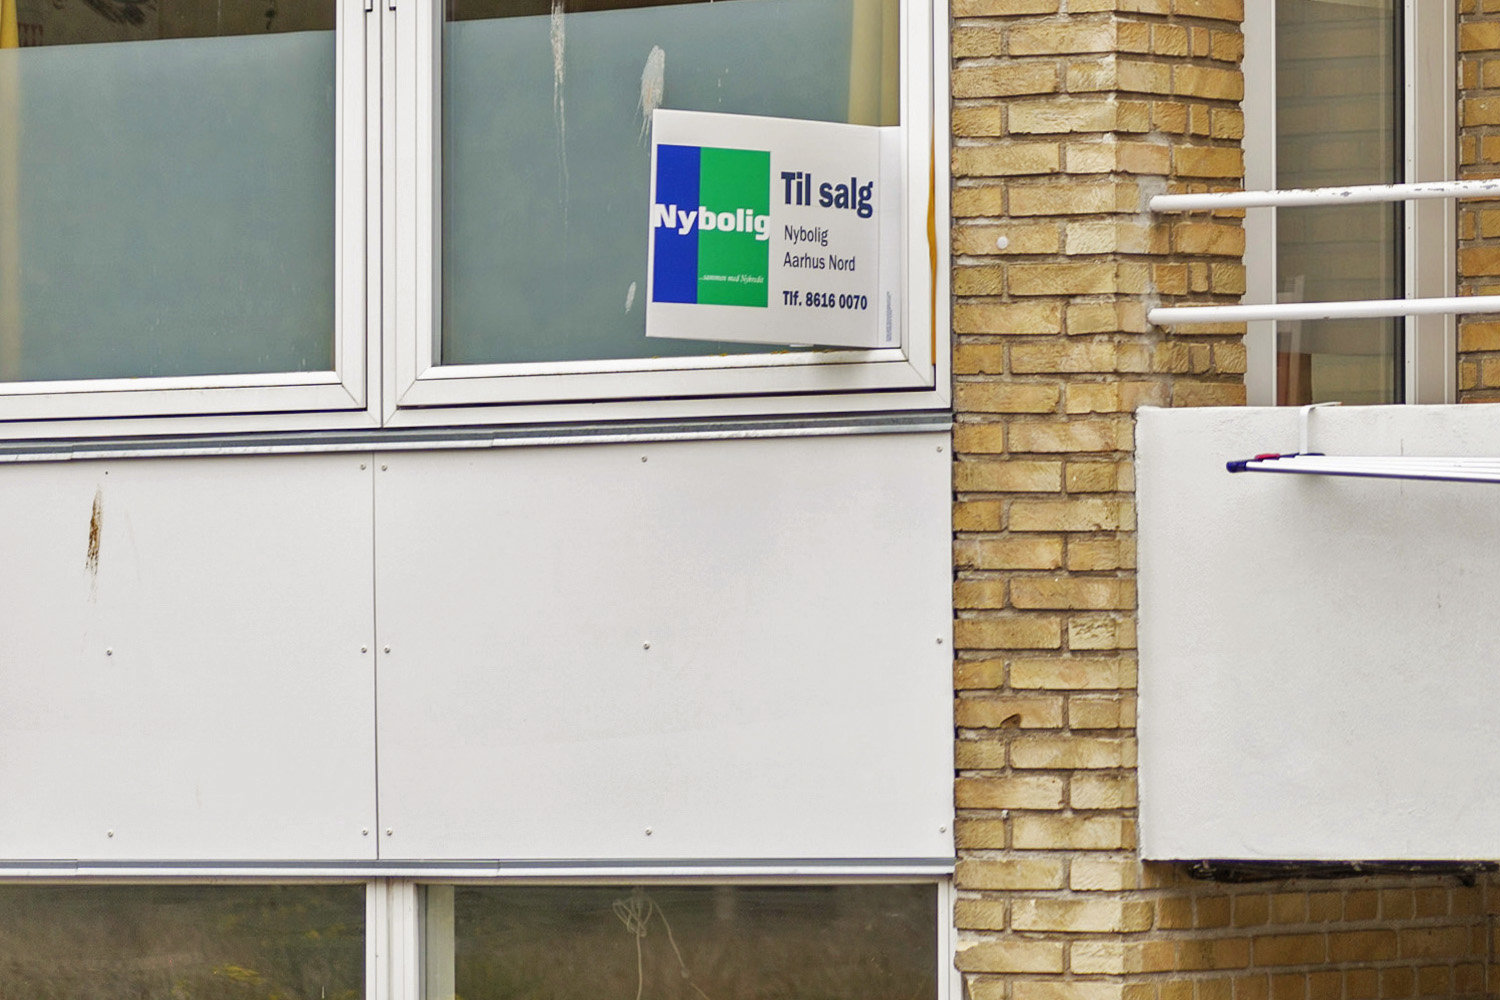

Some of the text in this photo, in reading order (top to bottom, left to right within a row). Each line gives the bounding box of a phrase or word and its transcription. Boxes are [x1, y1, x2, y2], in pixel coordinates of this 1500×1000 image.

[780, 171, 874, 218] Til salg
[653, 203, 771, 241] Nybolig
[784, 225, 829, 247] Nybolig
[783, 252, 856, 271] Aarhus Nord
[783, 290, 868, 310] Tlf. 8616 0070
